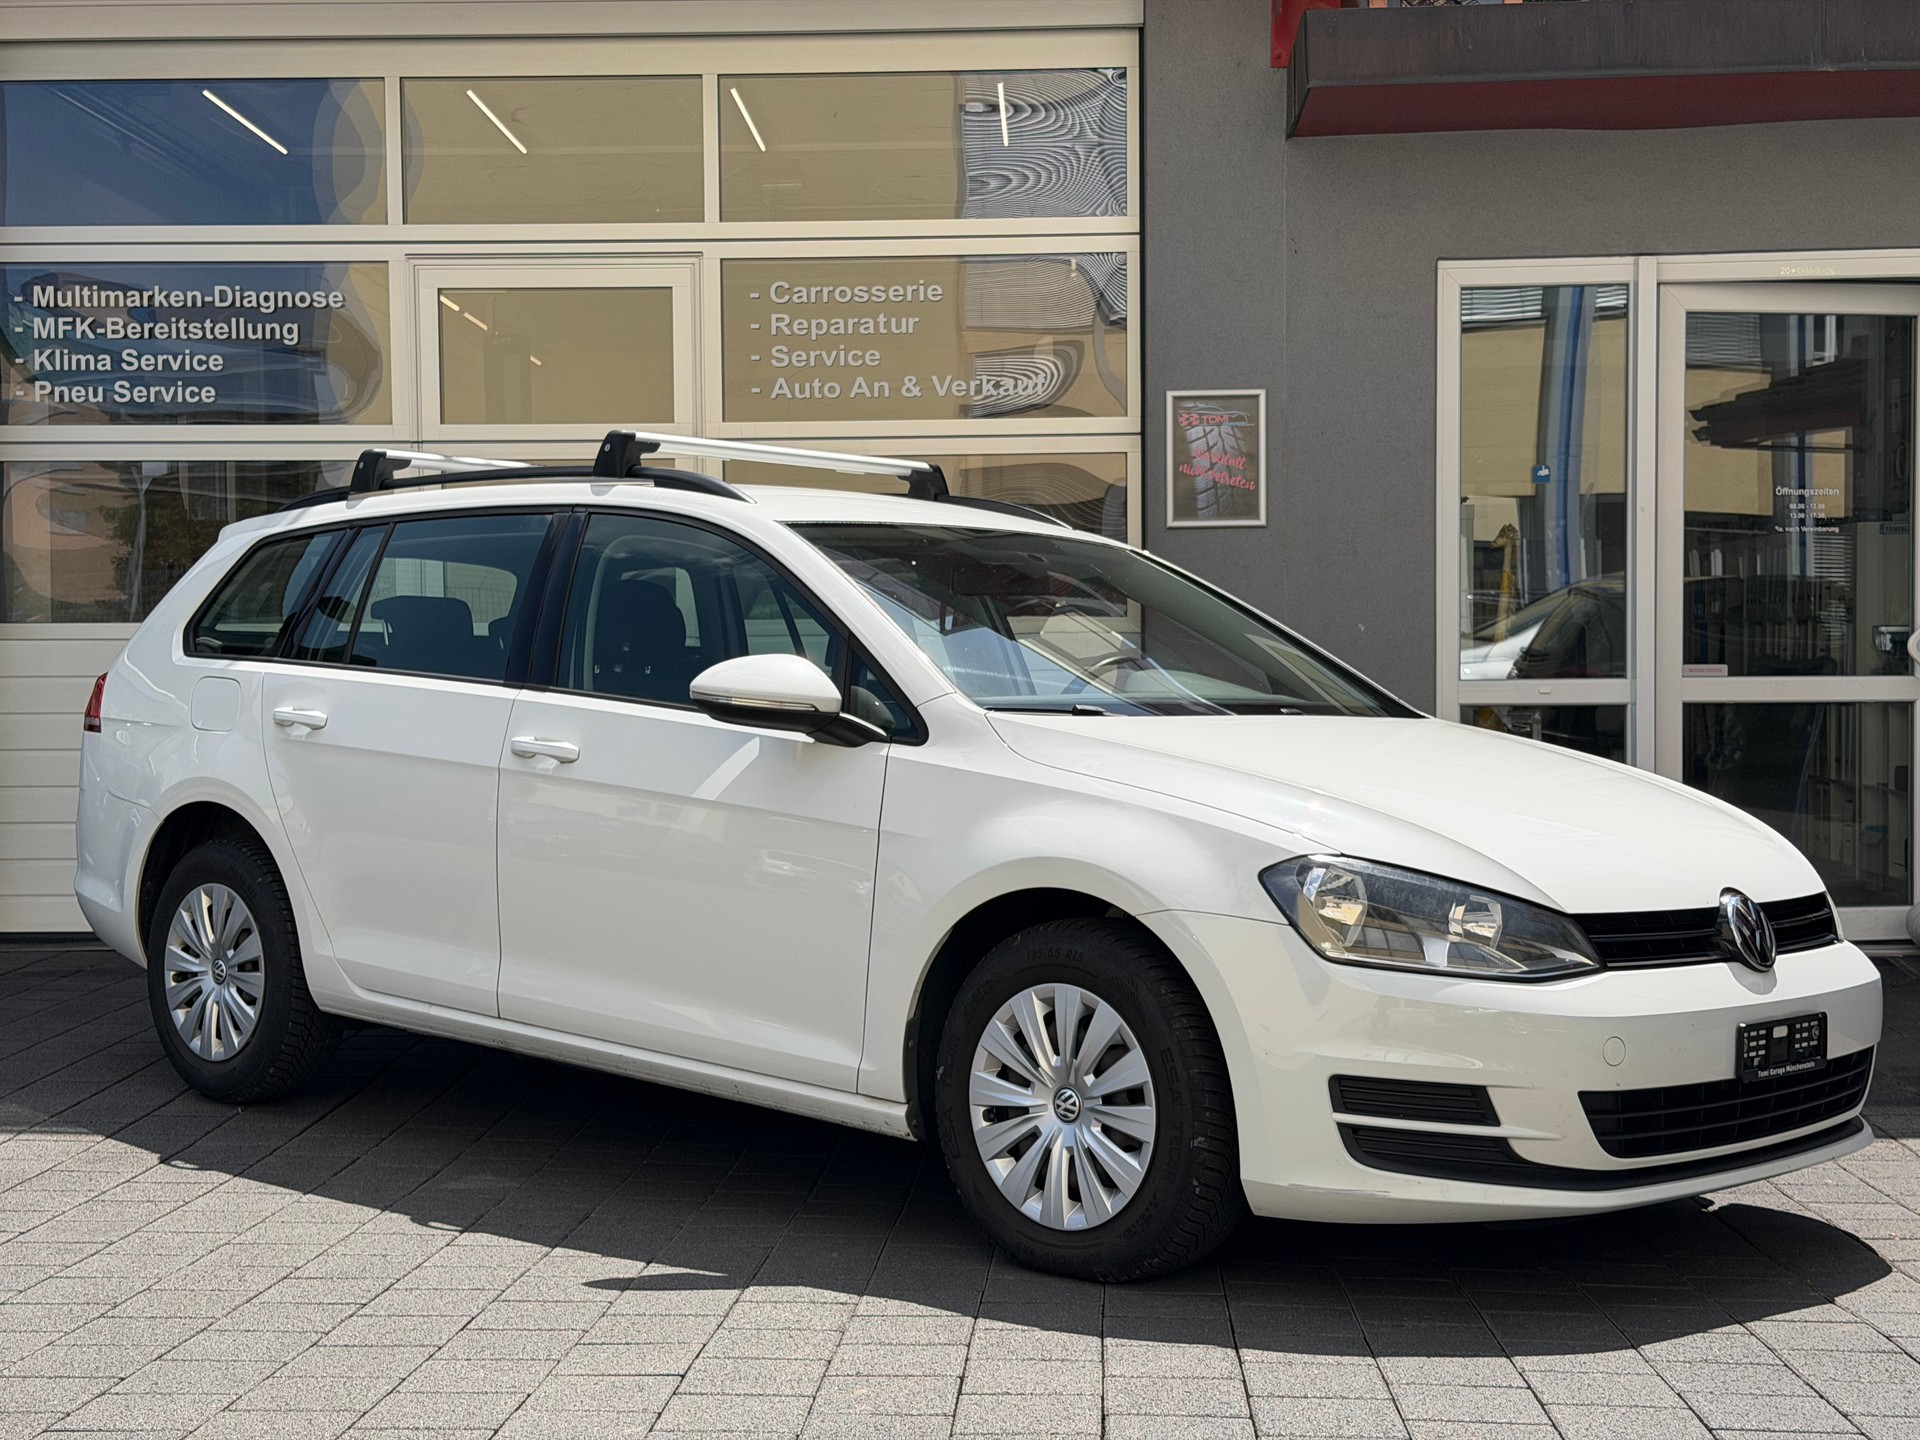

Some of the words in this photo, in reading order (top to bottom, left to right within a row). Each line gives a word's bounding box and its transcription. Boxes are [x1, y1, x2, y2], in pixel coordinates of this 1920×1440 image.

[33, 285, 345, 312] Multimarken-Diagnose
[770, 280, 944, 305] Carrosserie
[34, 317, 300, 345] MFK-Bereitstellung
[770, 312, 920, 340] Reparatur
[34, 349, 112, 371] Klima
[121, 349, 224, 372] Service
[770, 344, 882, 368] Service
[35, 381, 104, 404] Pneu
[113, 380, 217, 404] Service
[771, 377, 841, 400] Auto
[850, 376, 890, 398] An
[901, 375, 922, 398] &
[932, 374, 1046, 398] Verkauf
[1202, 414, 1229, 424] TOMI
[1210, 468, 1256, 490] betreten
[1776, 486, 1840, 498] Öffnungszeiten
[1027, 947, 1060, 962] 195/65
[1758, 1069, 1769, 1078] Tomi
[1770, 1066, 1785, 1076] Garage
[1786, 1060, 1815, 1072] Münchenstein
